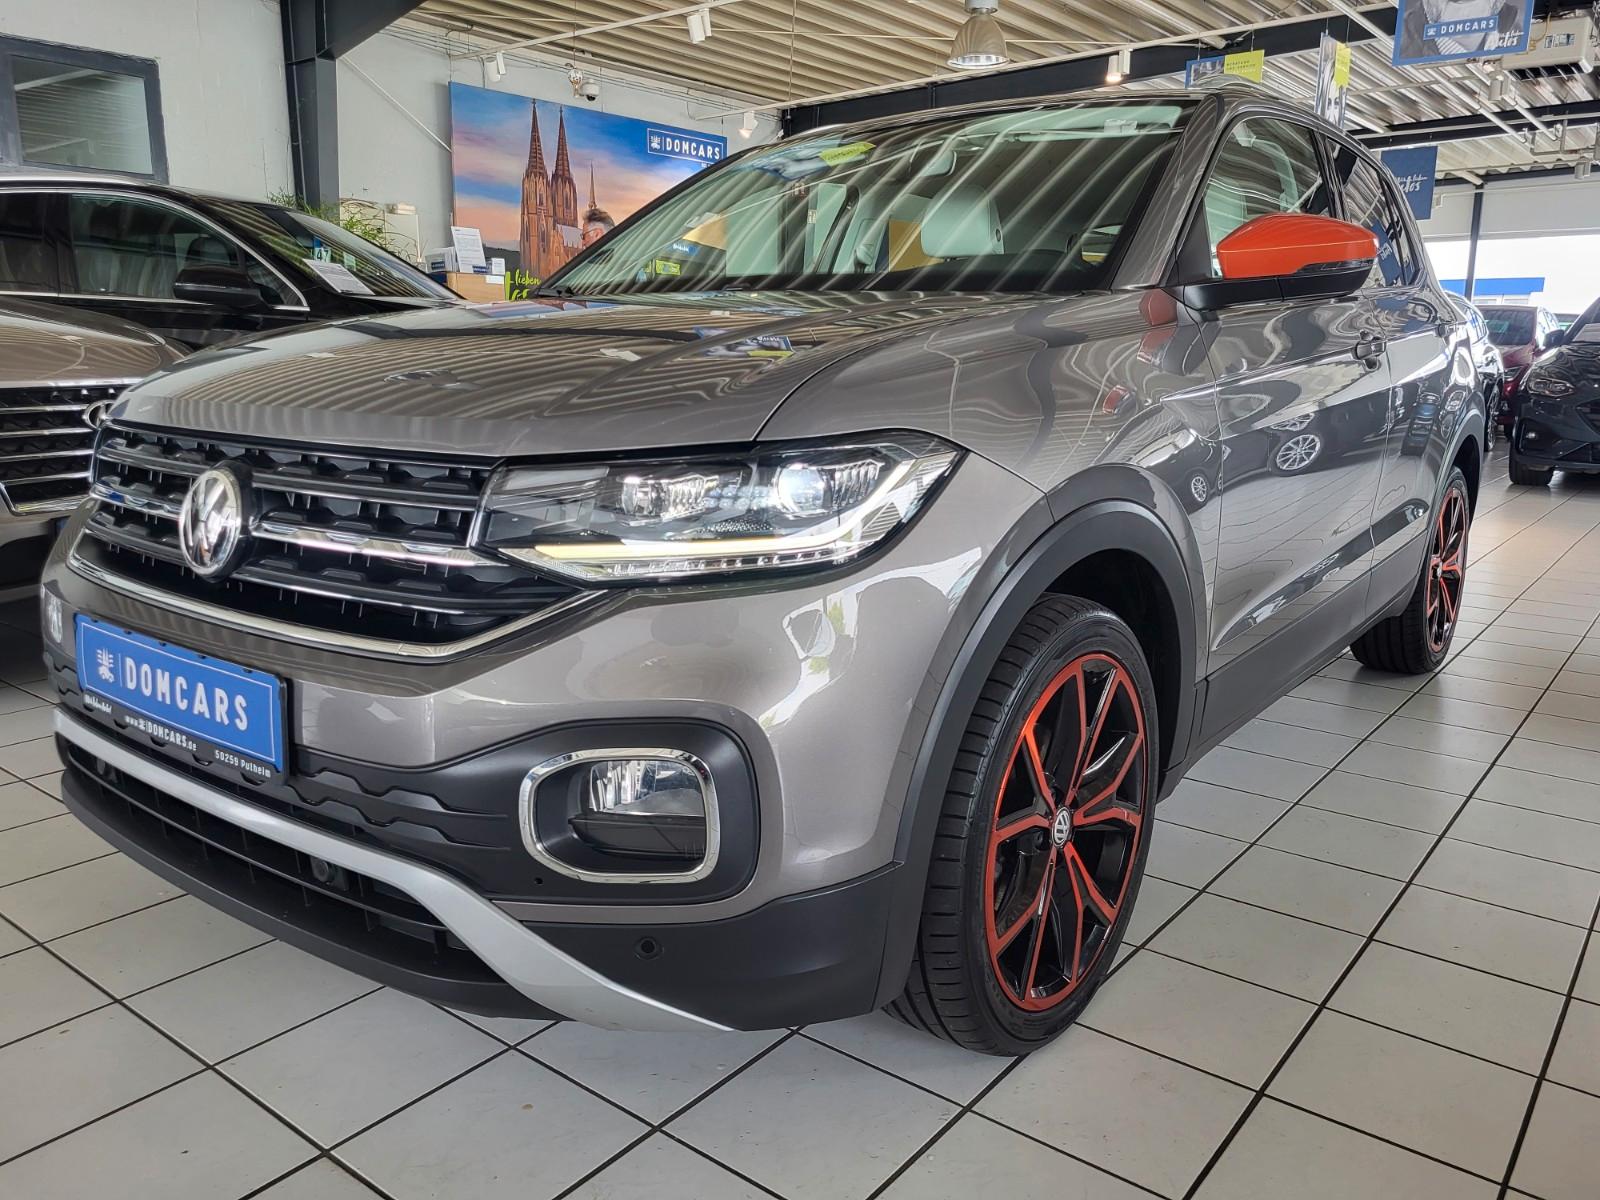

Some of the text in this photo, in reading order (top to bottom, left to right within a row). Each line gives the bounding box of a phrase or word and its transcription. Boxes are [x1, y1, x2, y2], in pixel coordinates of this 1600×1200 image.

[1440, 19, 1495, 35] DOMCARS
[666, 137, 720, 160] DOMCARS
[515, 268, 542, 287] lieben
[125, 656, 249, 732] DOMCARS
[215, 750, 271, 778] 50259 Pulheim
